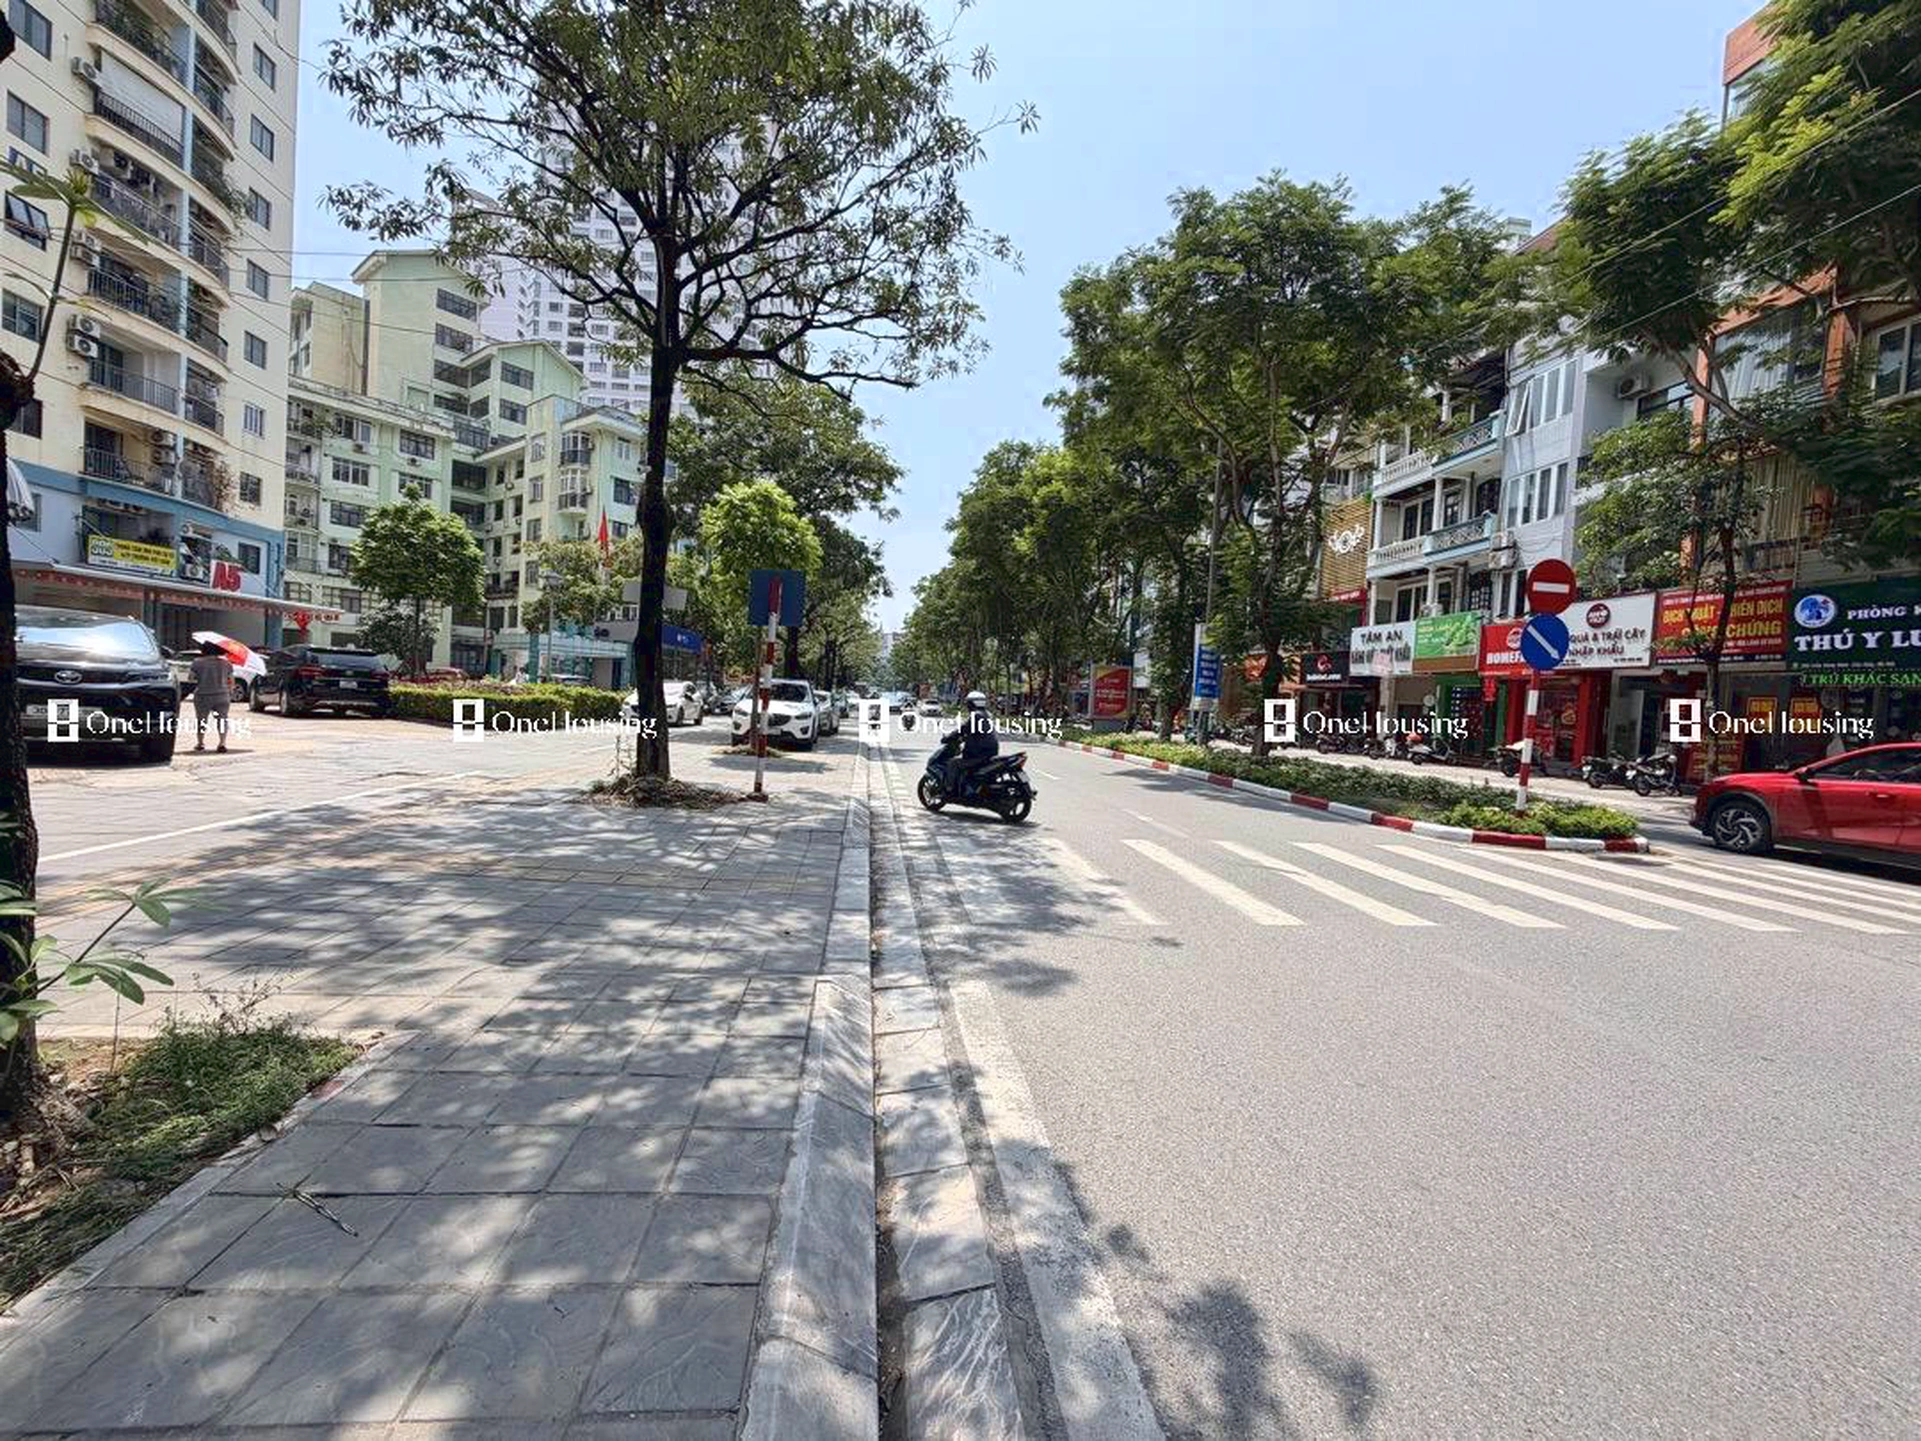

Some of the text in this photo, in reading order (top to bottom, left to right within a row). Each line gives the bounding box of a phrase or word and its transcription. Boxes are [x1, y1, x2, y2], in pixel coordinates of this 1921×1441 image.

[1847, 605, 1907, 620] PHÒNG
[1794, 628, 1855, 651] THÚ
[1861, 631, 1883, 648] Y
